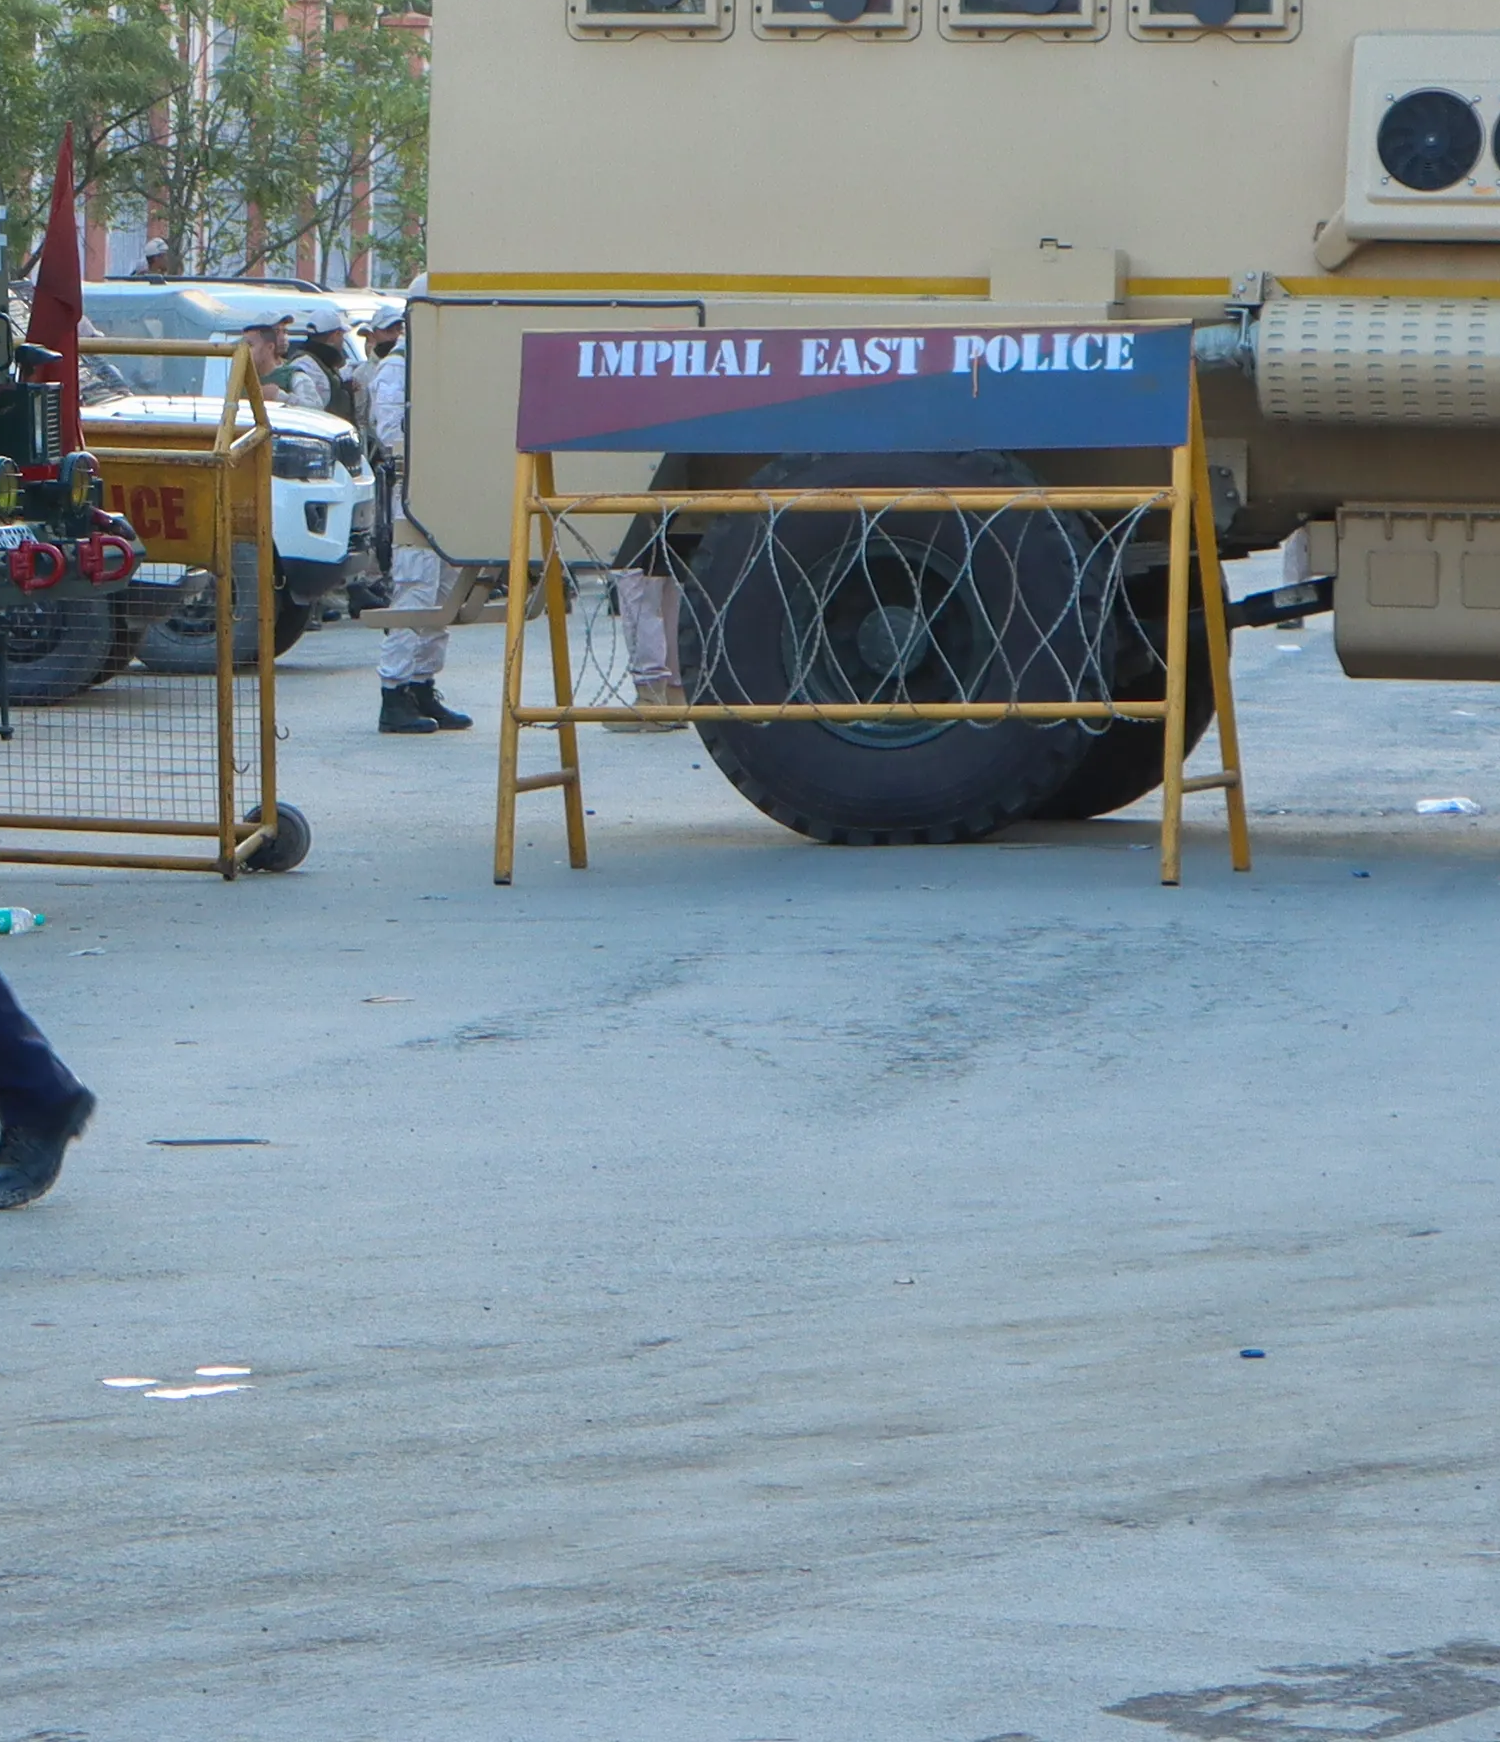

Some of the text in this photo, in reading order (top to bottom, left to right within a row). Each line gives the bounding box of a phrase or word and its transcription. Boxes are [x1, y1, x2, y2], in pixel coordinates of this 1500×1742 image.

[577, 332, 1136, 378] IMPHAL EAST POLICE
[109, 484, 189, 540] ICE
